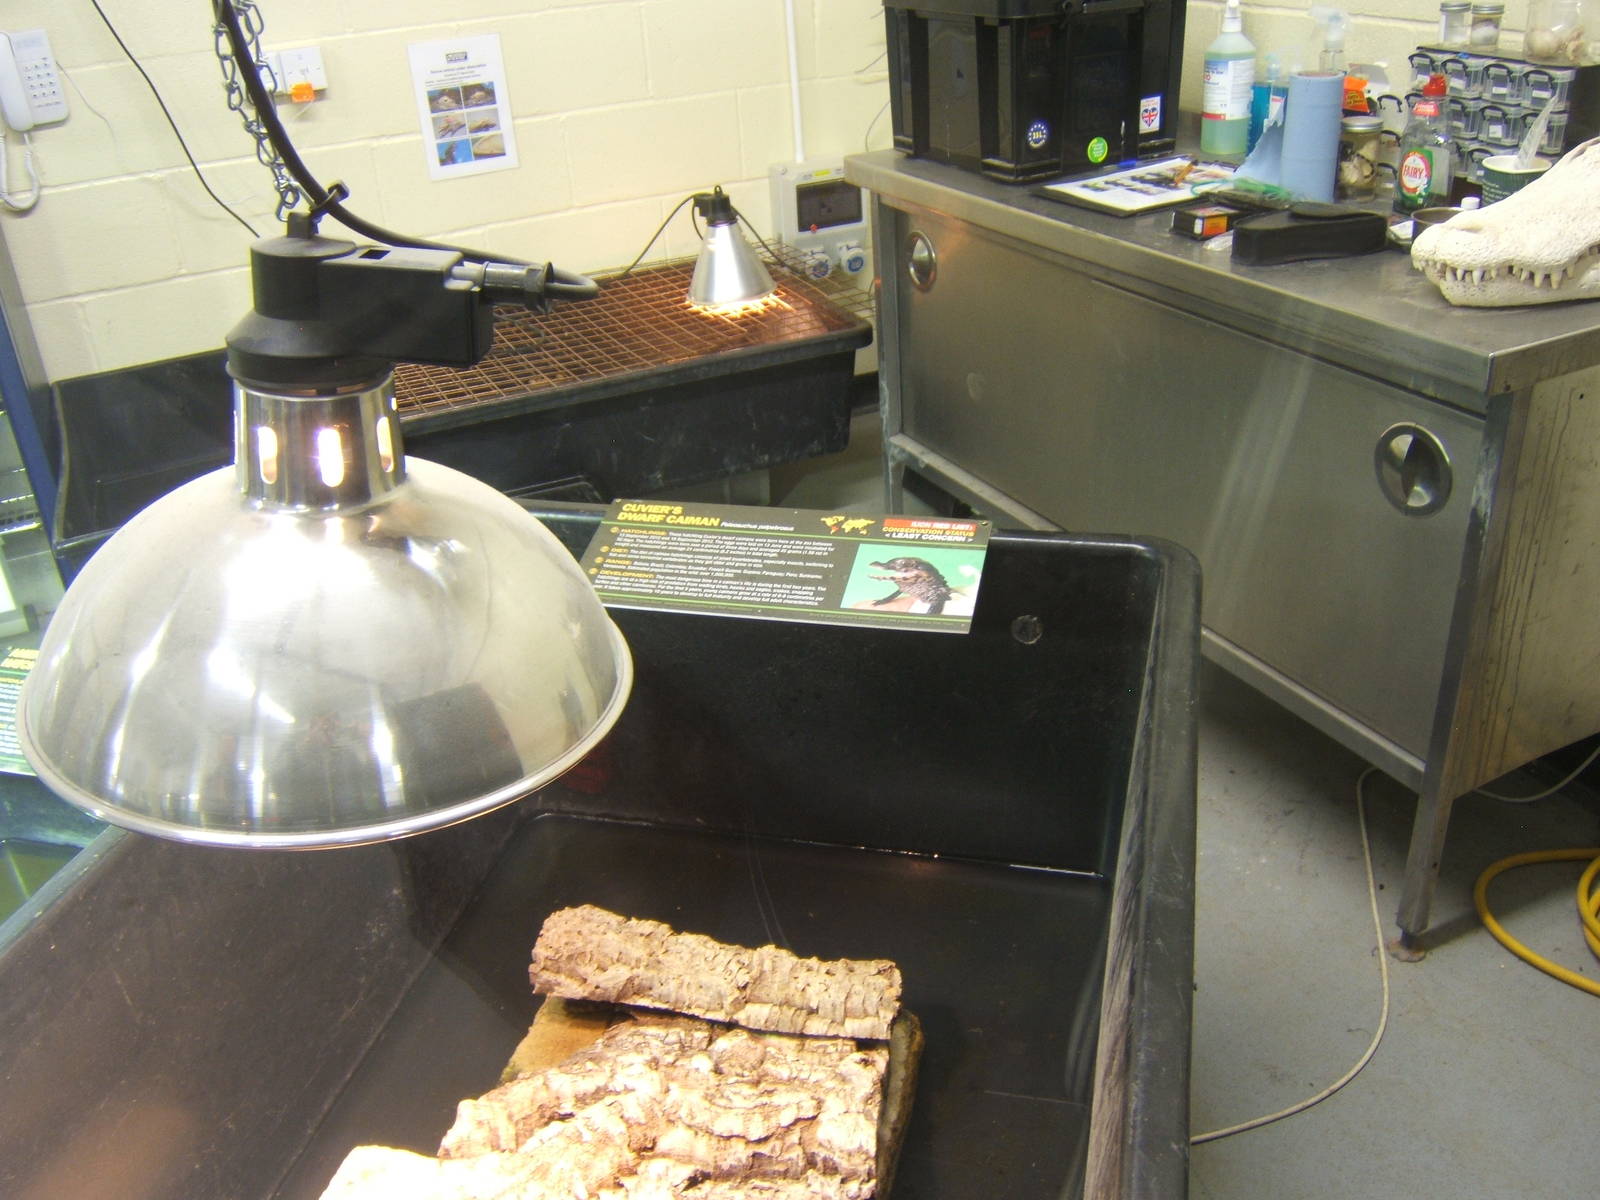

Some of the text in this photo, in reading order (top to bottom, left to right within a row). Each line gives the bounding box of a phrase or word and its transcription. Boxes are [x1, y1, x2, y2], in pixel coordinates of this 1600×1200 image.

[1403, 164, 1425, 180] FAIRY
[622, 503, 683, 515] CUVIER'S
[617, 512, 666, 523] DWARF
[666, 515, 720, 527] CAIMAN
[882, 526, 944, 535] CONSERVATION
[921, 534, 966, 542] CONCERN
